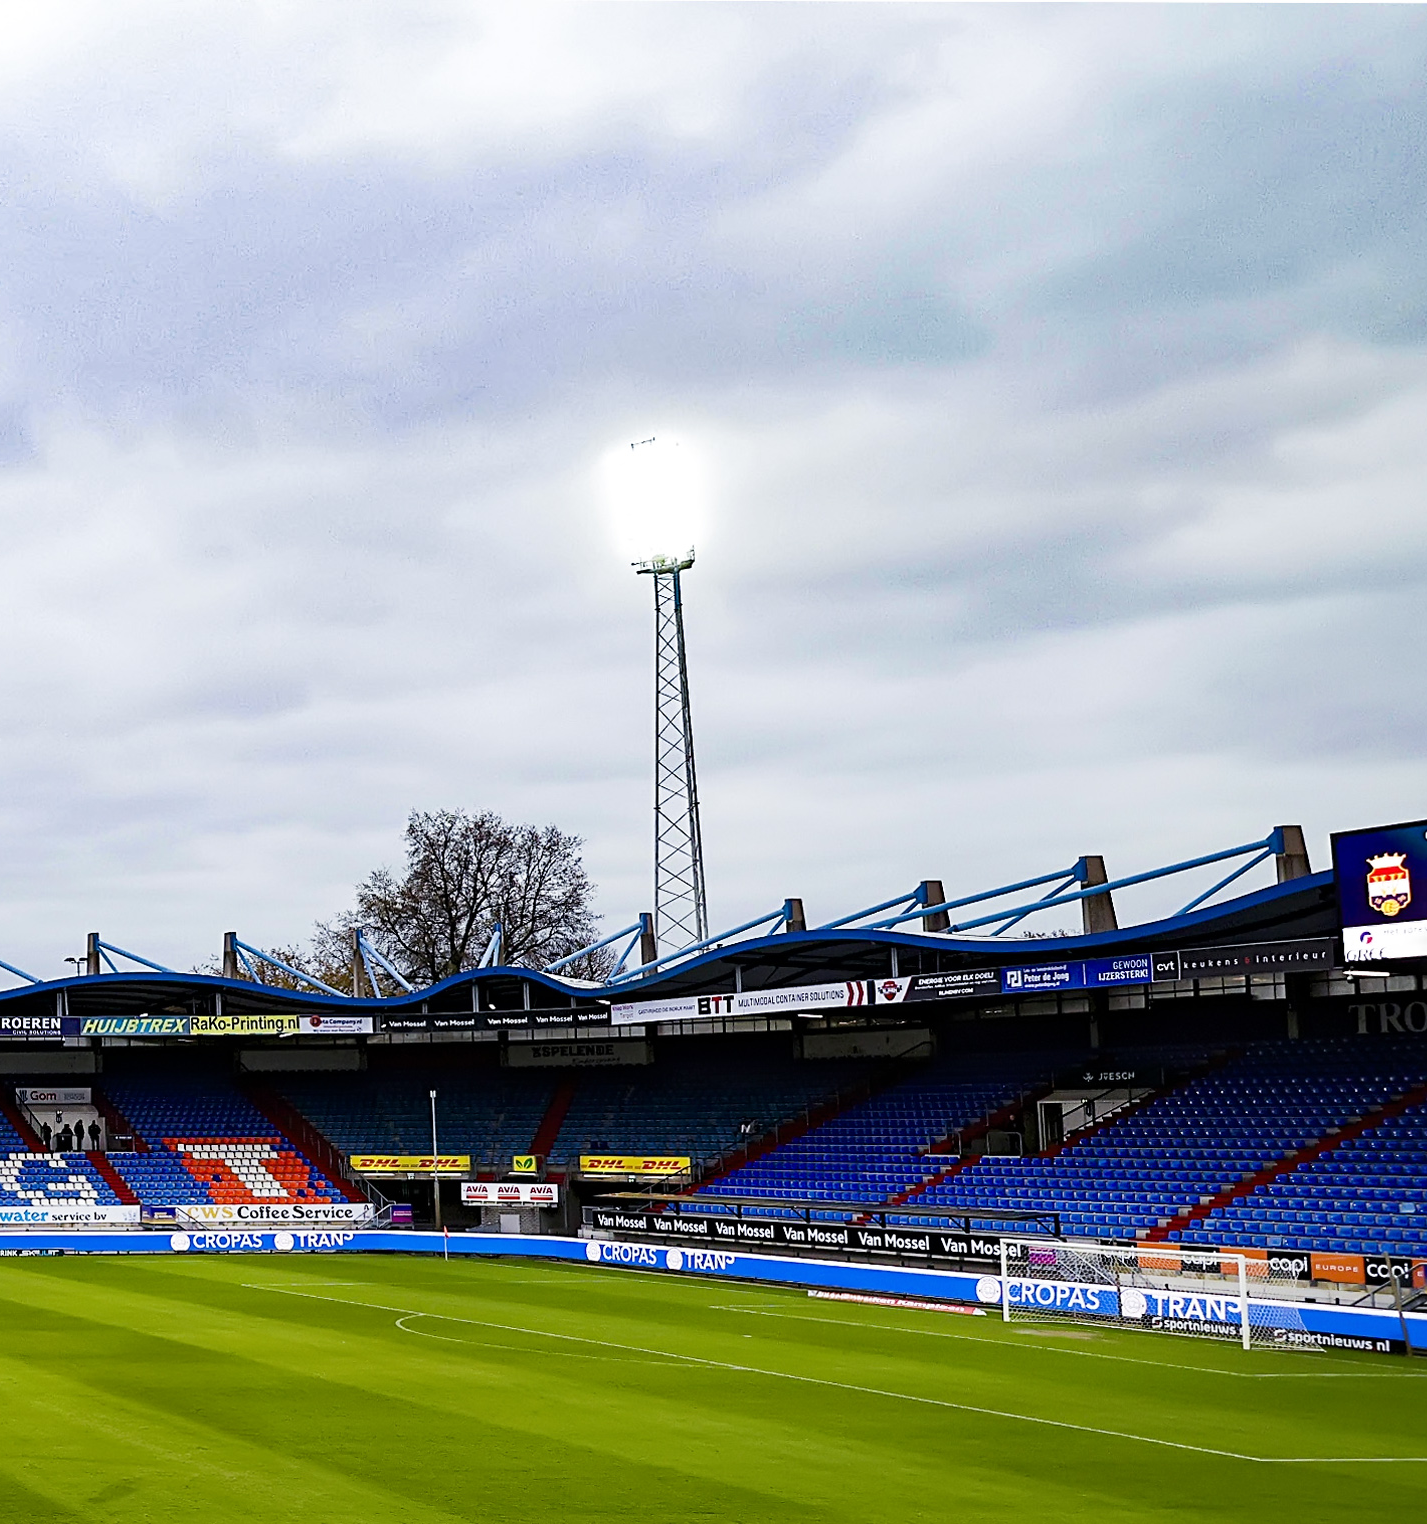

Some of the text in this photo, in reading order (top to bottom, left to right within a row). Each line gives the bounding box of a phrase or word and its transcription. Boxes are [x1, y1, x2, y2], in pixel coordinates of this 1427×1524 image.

[1113, 958, 1148, 970] GEWOON
[1183, 950, 1327, 969] keukens interieur
[1157, 961, 1175, 972] cvt
[1023, 972, 1069, 982] Peter Jong
[1099, 968, 1149, 982] IJZERSTERK!
[809, 989, 844, 1001] SOLUTIONS
[698, 996, 735, 1015] BTT
[487, 1017, 528, 1026] Van Mossel
[549, 1015, 573, 1023] Mossel
[590, 1012, 608, 1020] Mossel
[83, 1017, 187, 1034] HUIJBTREX
[190, 1015, 300, 1032] RaKo-Printing.nl
[402, 1020, 426, 1028] Mossel
[449, 1019, 475, 1027] Mossel
[30, 1090, 57, 1101] Gom
[359, 1158, 401, 1168] DHL
[419, 1159, 462, 1168] DHL
[587, 1160, 626, 1169] DHL
[641, 1161, 683, 1170] DHL
[51, 1212, 91, 1221] service
[94, 1211, 107, 1220] bv
[187, 1206, 353, 1220] CWS Coffee Service
[597, 1214, 647, 1229] Van Mossel
[653, 1218, 707, 1234] Van Mossel
[716, 1222, 774, 1239] Van Mossel
[783, 1227, 848, 1244] Van Mossel
[193, 1233, 263, 1249] CROPAS
[859, 1232, 929, 1250] Van Mossel
[941, 1238, 1021, 1258] Van Mossel
[603, 1244, 657, 1266] CROPAS
[1315, 1264, 1359, 1273] EUROPE
[1008, 1281, 1100, 1310] CROPAS
